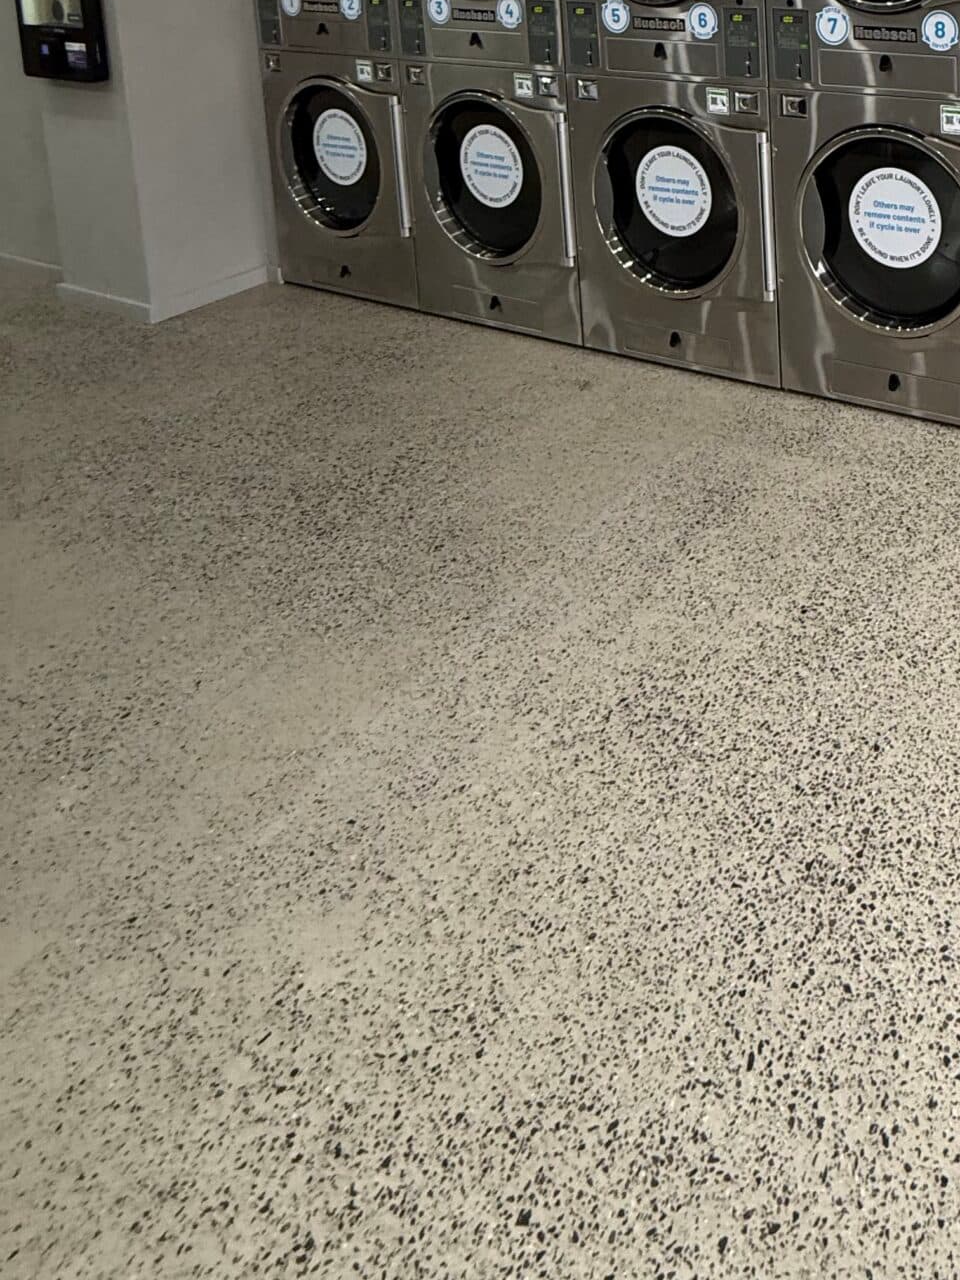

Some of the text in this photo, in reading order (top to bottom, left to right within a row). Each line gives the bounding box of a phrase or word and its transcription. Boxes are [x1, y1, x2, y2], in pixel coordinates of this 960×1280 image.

[435, 1, 443, 15] 3
[505, 4, 513, 18] 4
[611, 8, 620, 23] 5
[698, 13, 707, 28] 6
[828, 18, 837, 34] 7
[855, 26, 916, 41] Huebsch
[935, 21, 946, 38] 8
